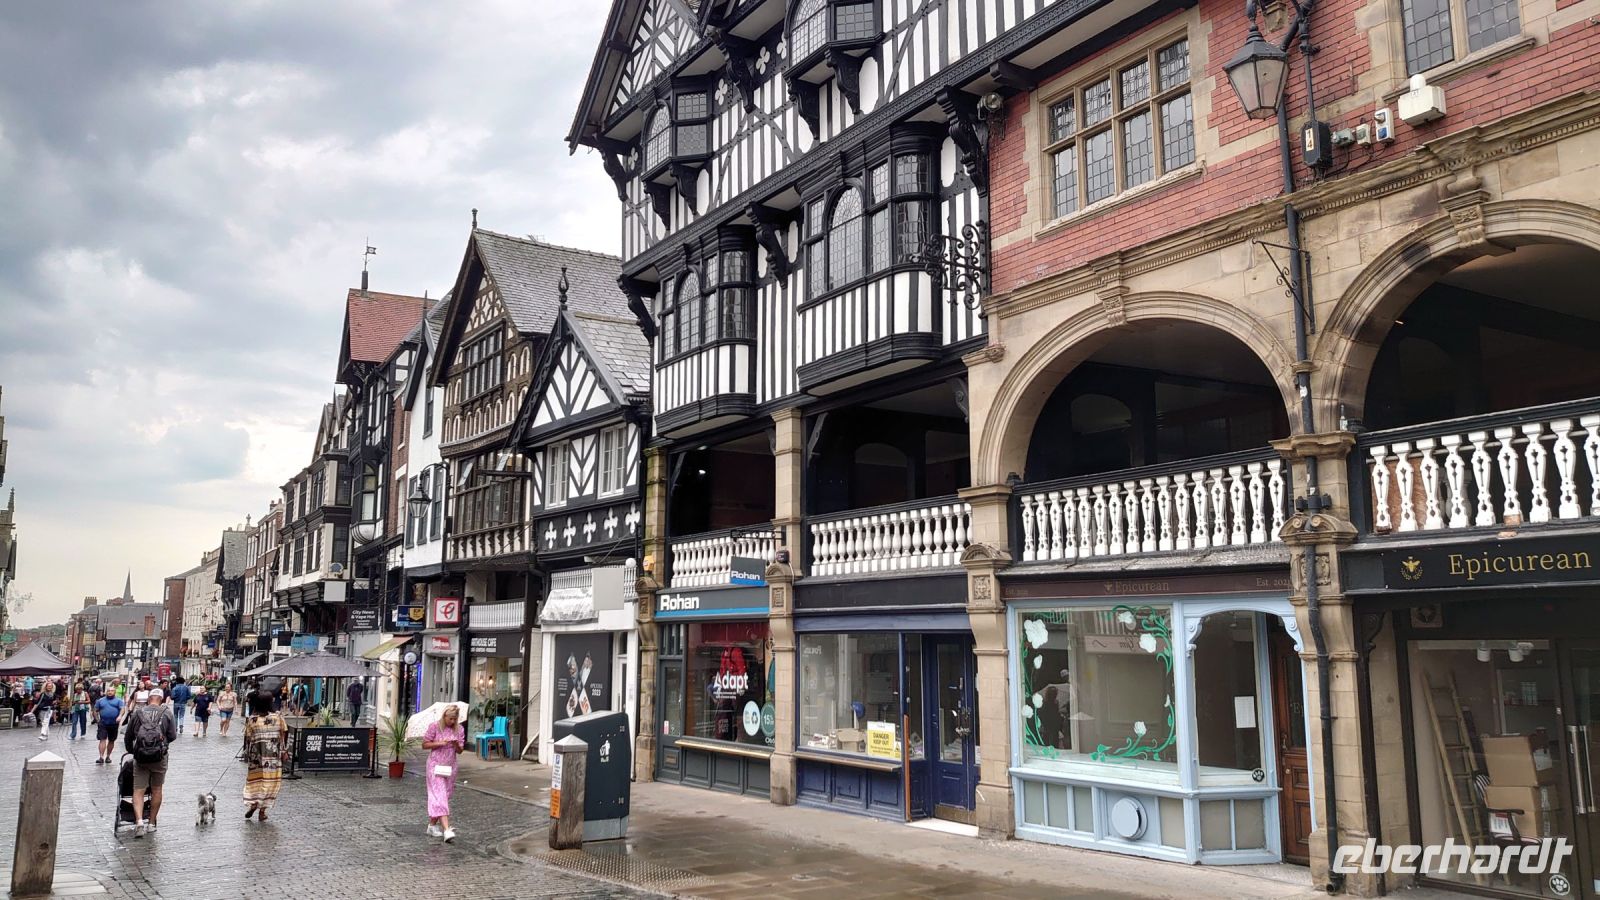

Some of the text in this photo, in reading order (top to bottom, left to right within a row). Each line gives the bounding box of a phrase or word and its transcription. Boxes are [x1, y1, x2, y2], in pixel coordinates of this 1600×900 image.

[1448, 551, 1592, 580] Epicurean
[731, 570, 760, 580] Rohan
[1116, 581, 1169, 594] Epicurean
[660, 593, 700, 611] Rohan
[713, 670, 749, 694] Adapt
[873, 732, 889, 740] DANGER
